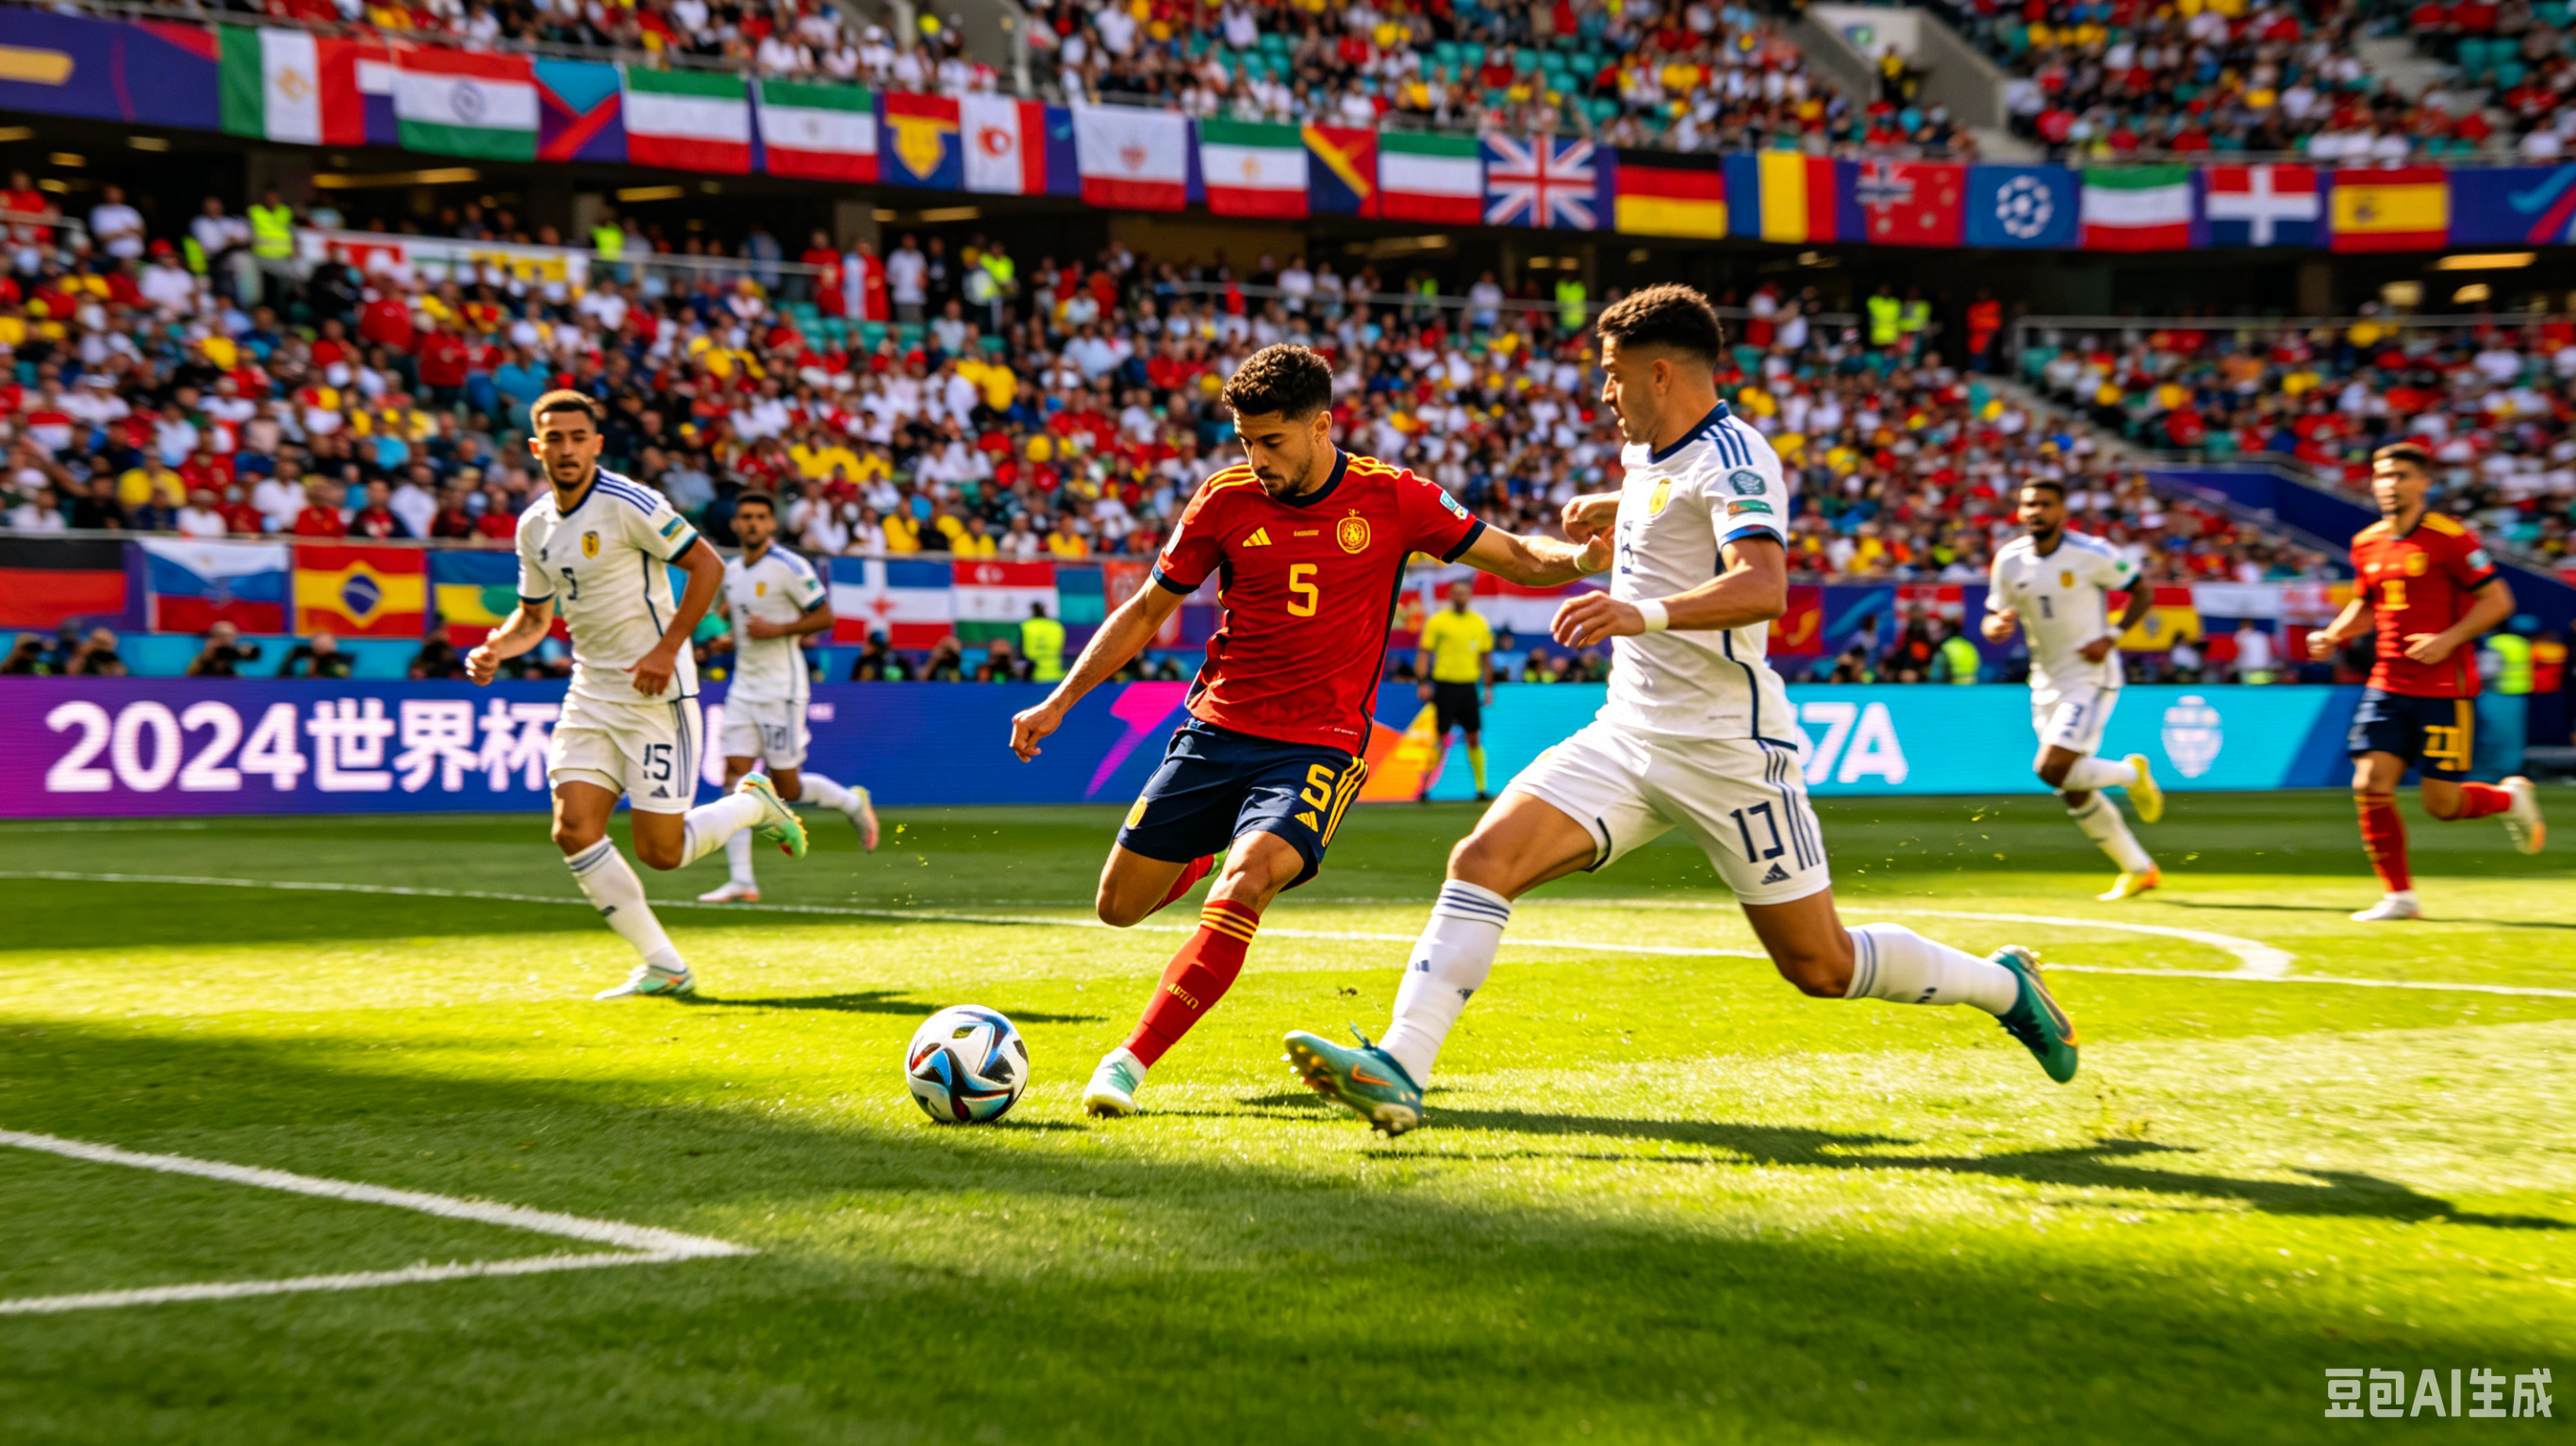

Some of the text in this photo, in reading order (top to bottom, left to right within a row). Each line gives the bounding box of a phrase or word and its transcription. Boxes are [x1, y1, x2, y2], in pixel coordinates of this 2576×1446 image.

[1287, 563, 1319, 617] 5
[44, 698, 562, 793] 2024世界杯
[643, 742, 673, 781] 15
[1299, 763, 1336, 813] 5
